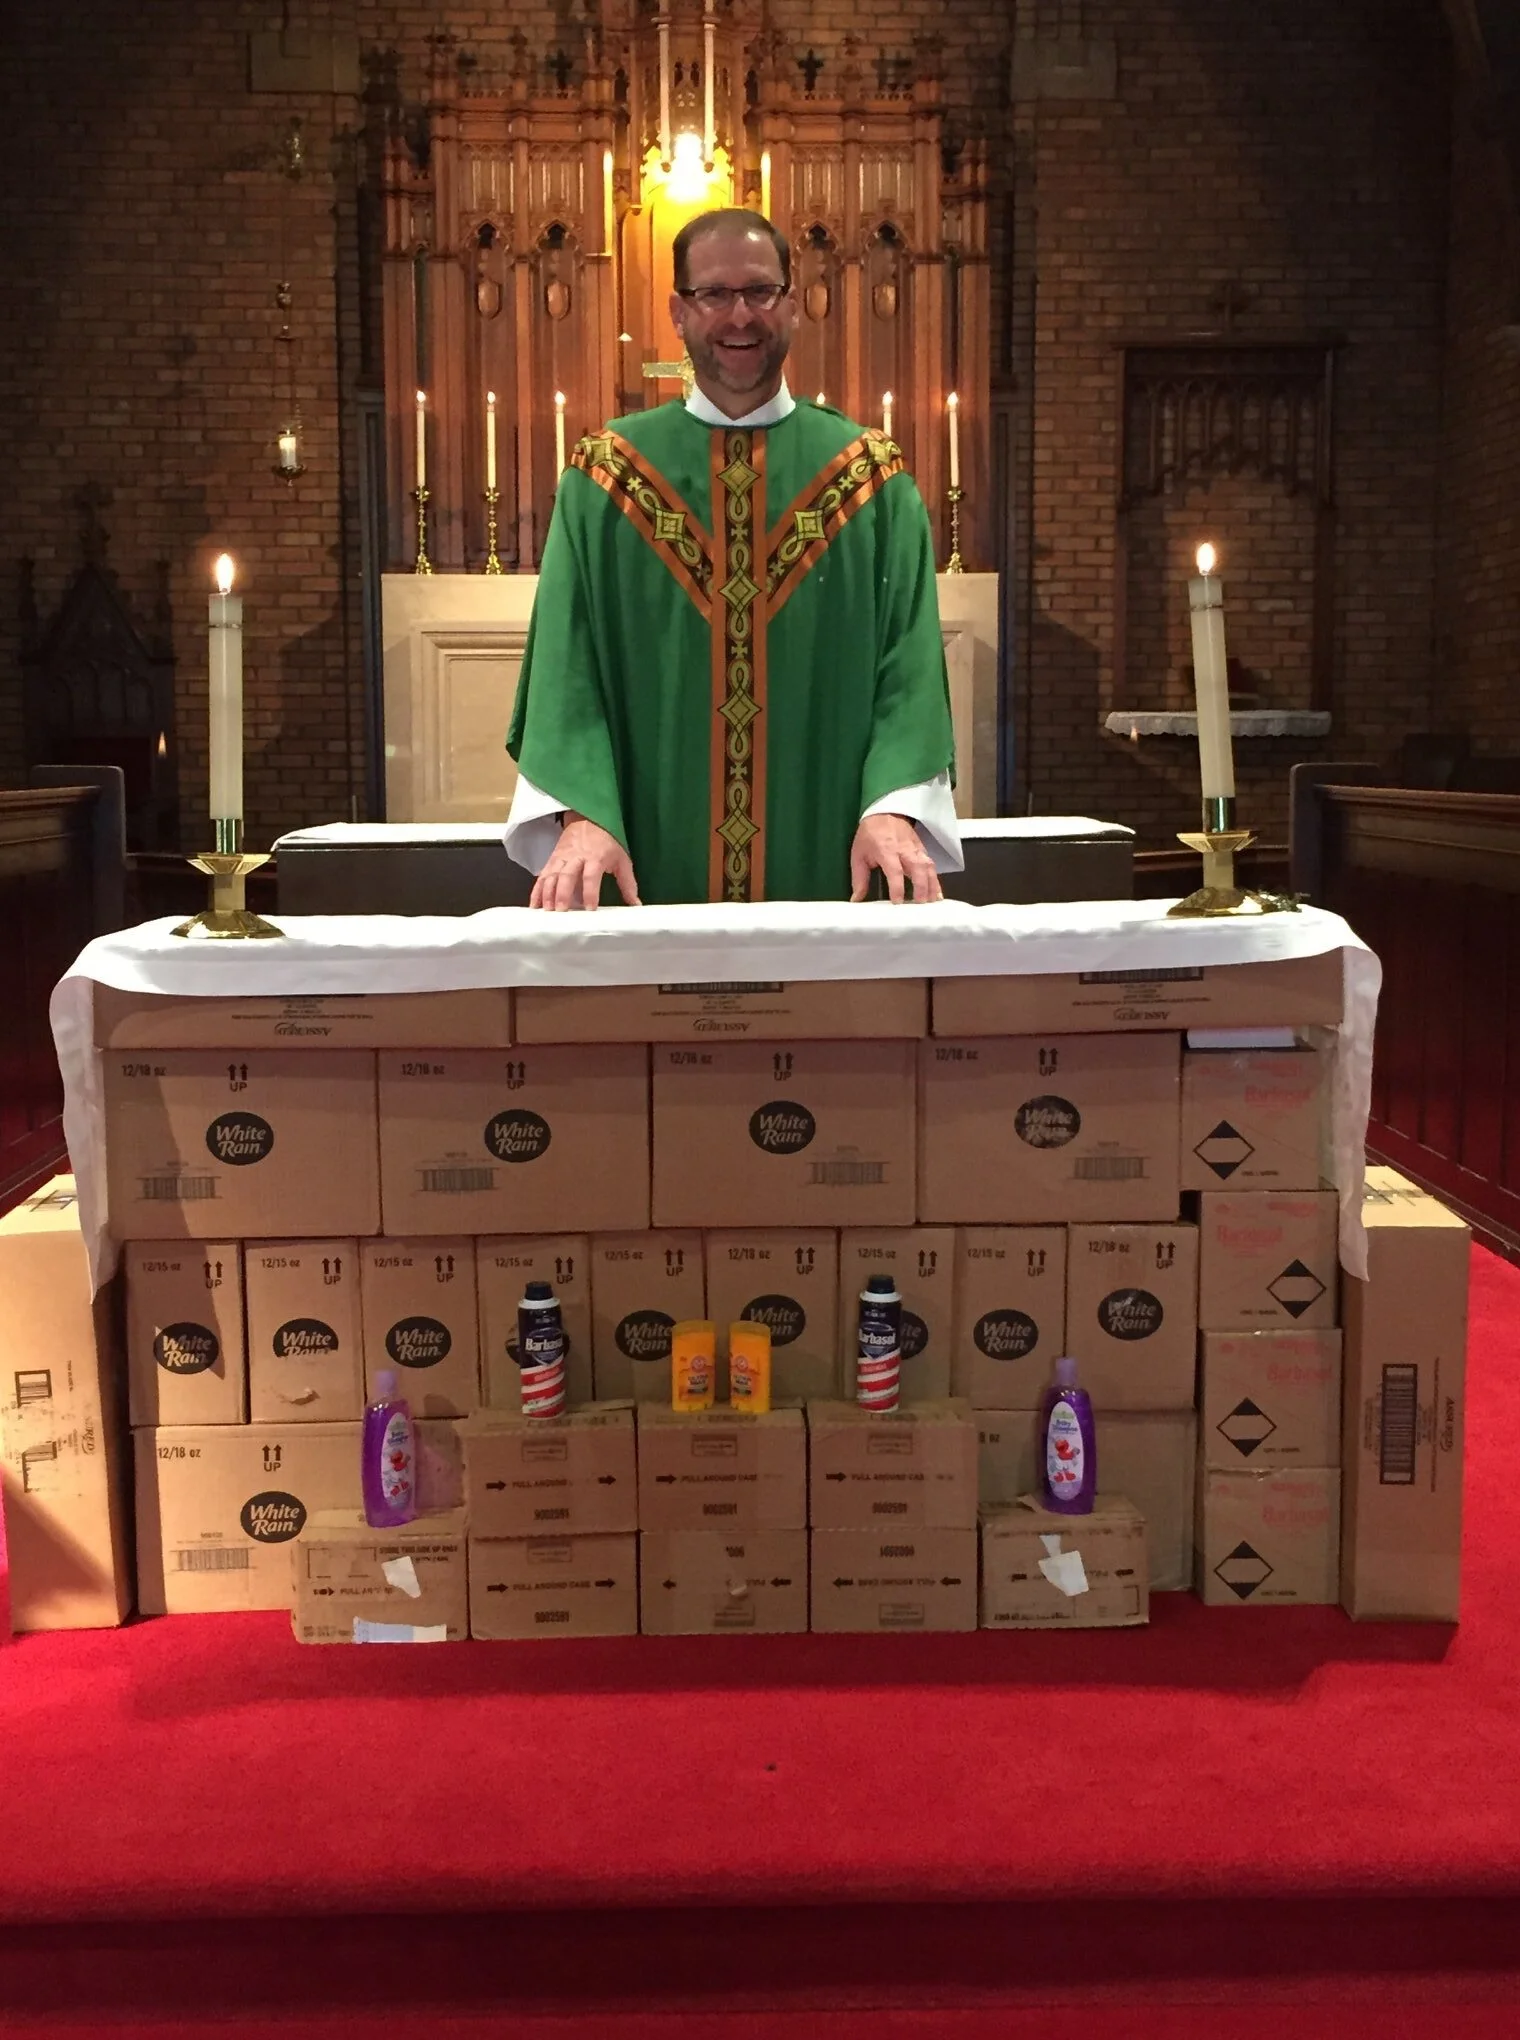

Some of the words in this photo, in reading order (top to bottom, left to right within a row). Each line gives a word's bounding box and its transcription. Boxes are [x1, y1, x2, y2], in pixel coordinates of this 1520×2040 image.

[153, 1066, 166, 1076] oz
[774, 1071, 791, 1081] UP
[1040, 1066, 1056, 1076] UP
[230, 1082, 248, 1092] UP
[506, 1080, 525, 1090] UP
[760, 1113, 808, 1131] White
[216, 1124, 266, 1142] White
[494, 1121, 544, 1139] White
[761, 1129, 803, 1145] Rain
[218, 1141, 260, 1157] Rain
[496, 1138, 538, 1154] Rain
[290, 1259, 300, 1268] oz
[402, 1258, 413, 1267] oz
[797, 1265, 813, 1275] UP
[1156, 1260, 1173, 1270] UP
[437, 1273, 454, 1283] UP
[666, 1267, 684, 1276] UP
[919, 1268, 935, 1277] UP
[1028, 1267, 1045, 1277] UP
[206, 1279, 222, 1289] UP
[324, 1276, 341, 1285] UP
[557, 1275, 573, 1284] UP
[750, 1307, 799, 1323] White
[1107, 1299, 1157, 1317] White
[771, 1323, 793, 1335] ain
[901, 1323, 921, 1338] ite
[983, 1321, 1032, 1338] White
[1109, 1316, 1151, 1332] Rain
[162, 1332, 212, 1352] White
[282, 1330, 331, 1347] White
[395, 1328, 444, 1345] White
[397, 1344, 439, 1360] Rain
[627, 1338, 668, 1354] Rain
[984, 1337, 1026, 1353] Rain
[164, 1350, 206, 1366] Rain
[158, 1447, 186, 1460] 12/18
[189, 1449, 201, 1458] oz
[263, 1462, 281, 1472] UP
[250, 1503, 300, 1520] White
[251, 1518, 295, 1535] Rain
